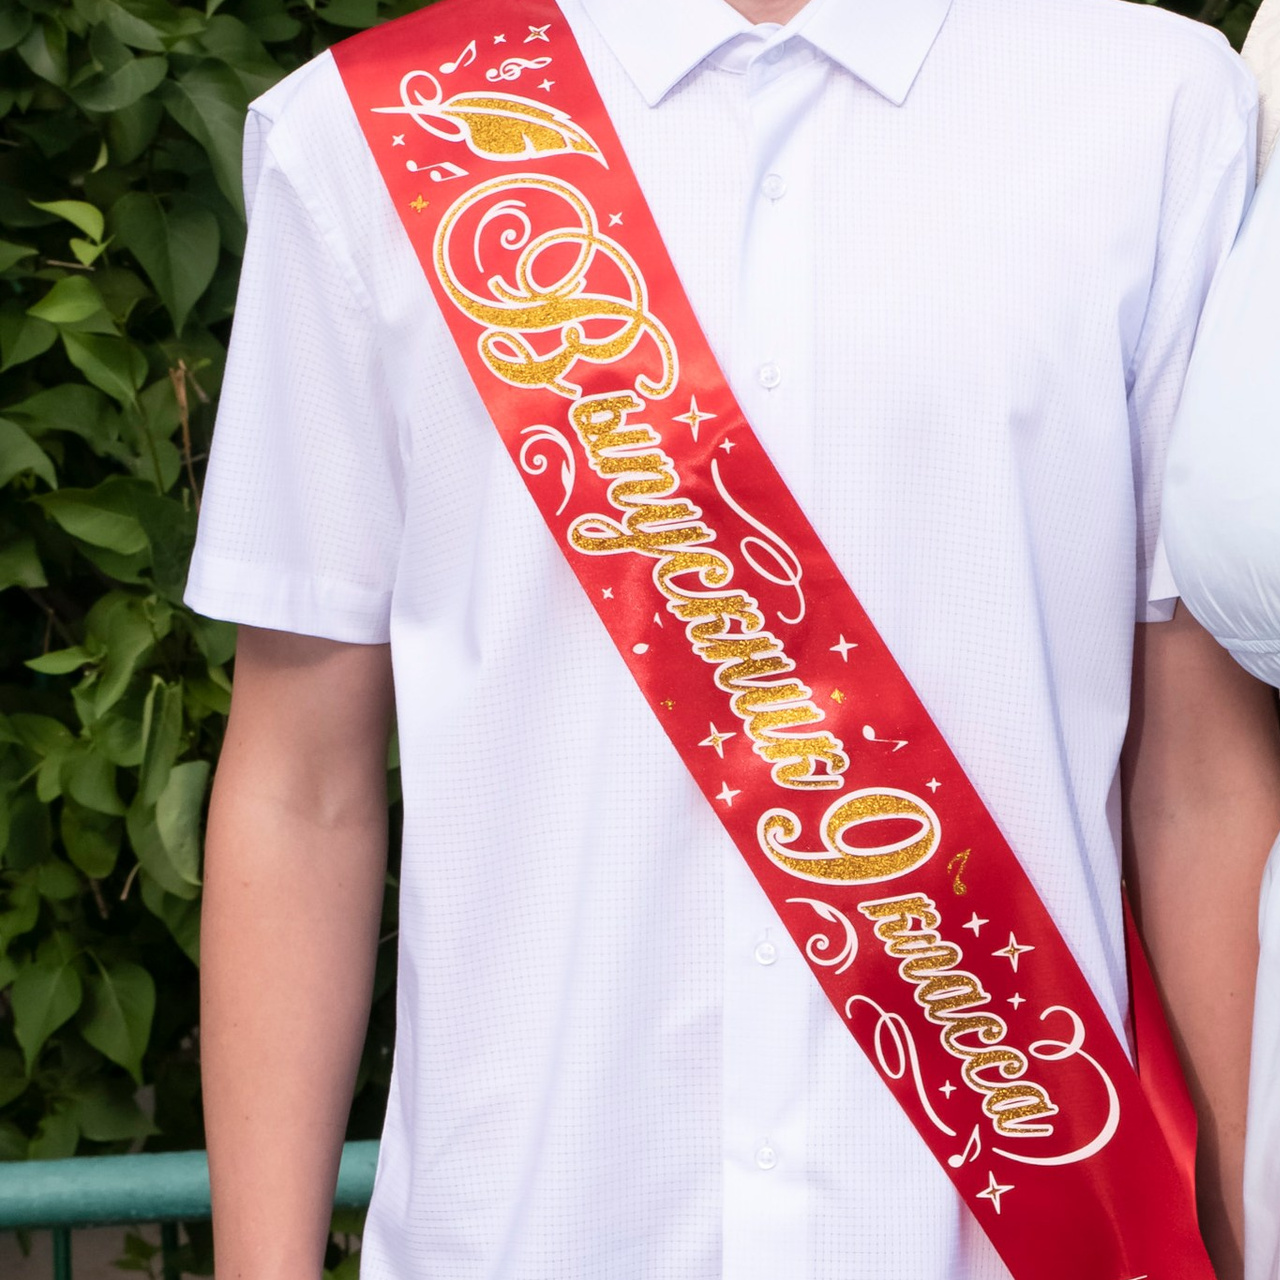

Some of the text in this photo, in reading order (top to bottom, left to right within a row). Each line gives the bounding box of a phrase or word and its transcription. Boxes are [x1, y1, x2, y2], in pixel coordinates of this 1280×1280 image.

[433, 172, 1059, 1137] Выпускник 9 класса
